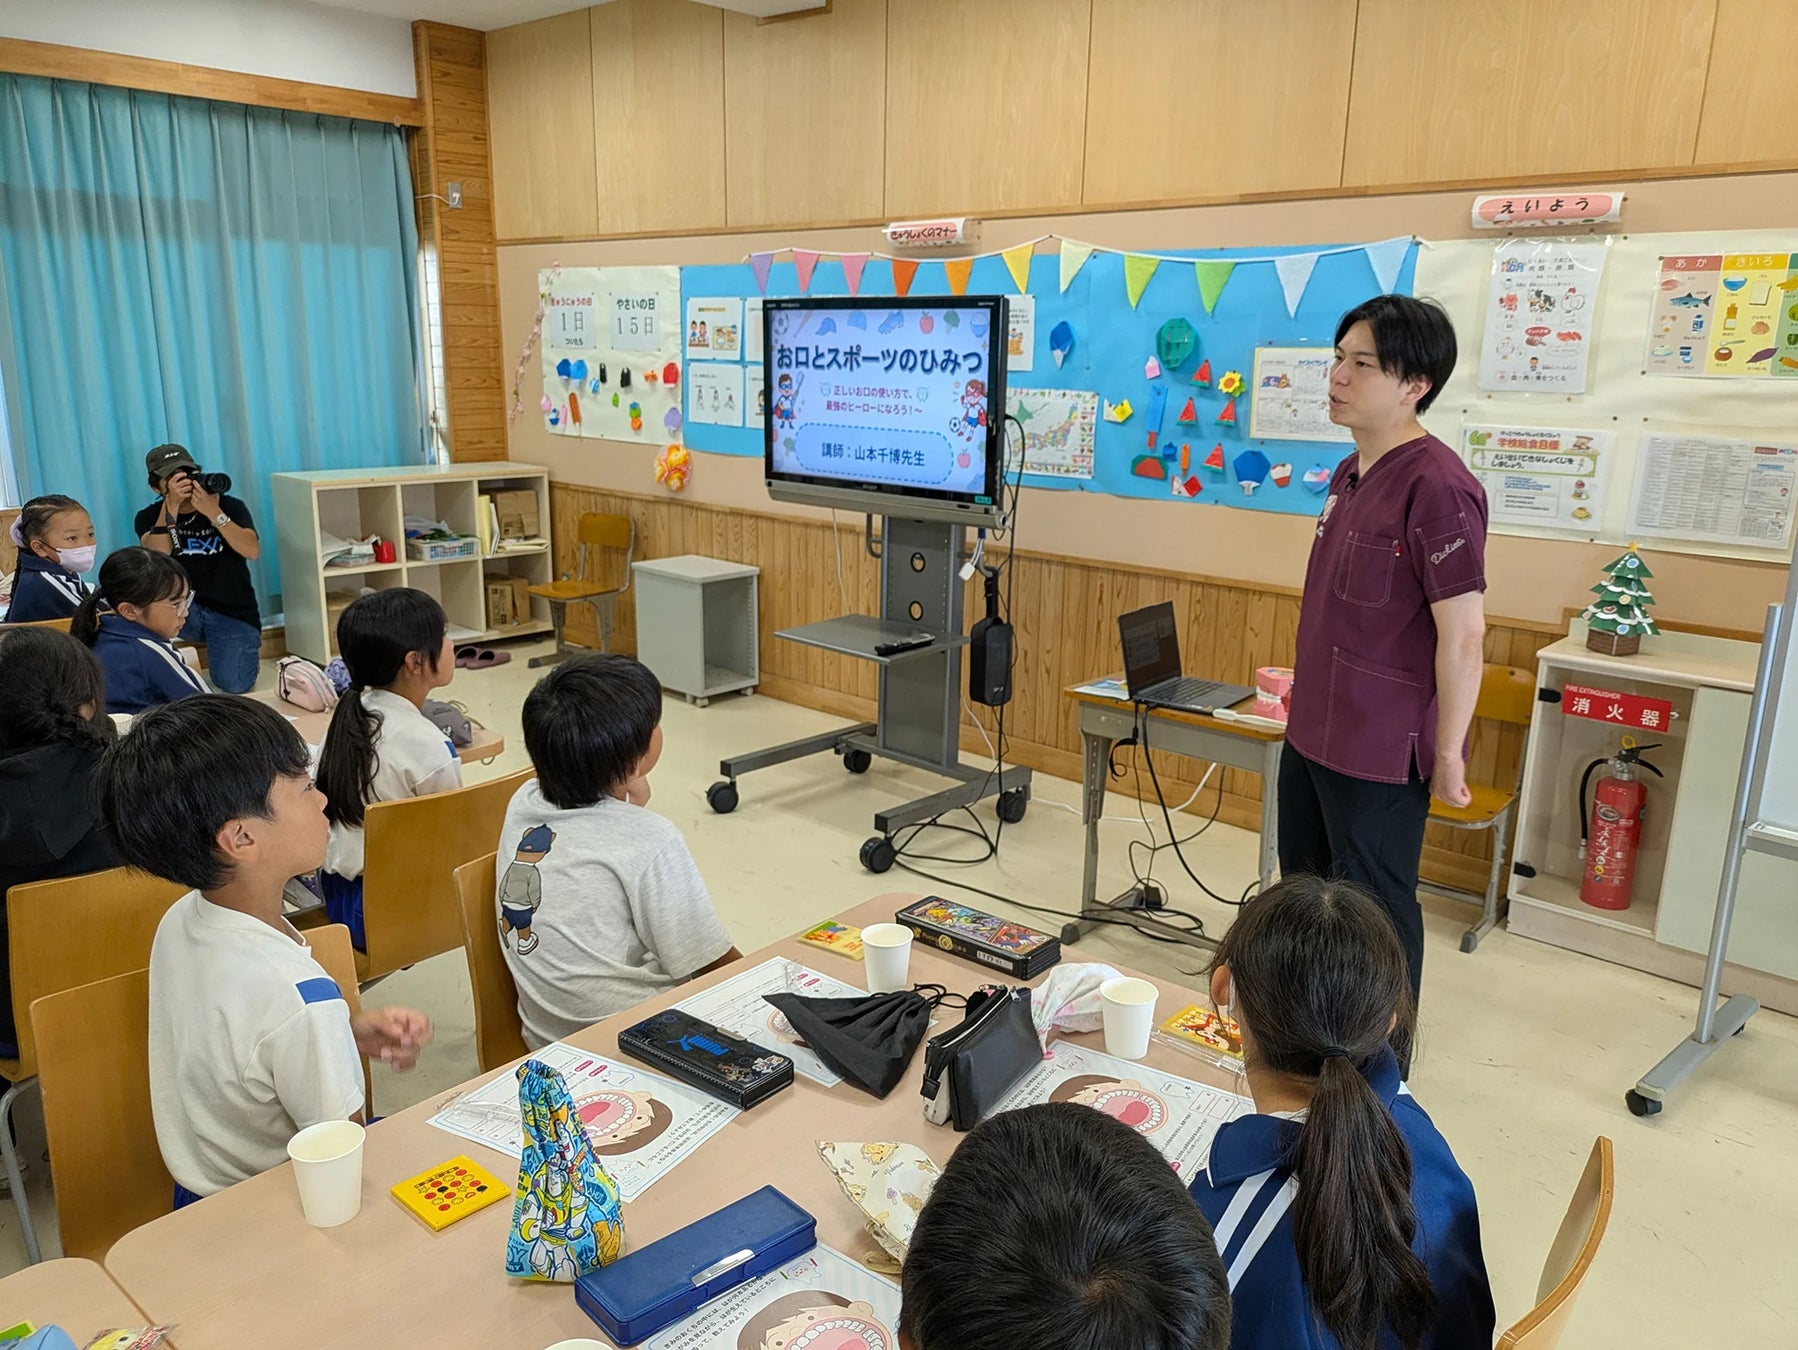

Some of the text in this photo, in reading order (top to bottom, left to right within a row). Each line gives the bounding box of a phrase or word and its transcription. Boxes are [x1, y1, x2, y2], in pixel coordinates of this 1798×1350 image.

[1500, 198, 1589, 214] えいよう
[1675, 259, 1708, 268] あか
[1736, 256, 1773, 267] きいろ
[617, 298, 655, 310] やさいの日
[777, 344, 983, 375] お口とスポーツのひみつ
[833, 385, 913, 399] 正しいお口の使い方で、
[171, 528, 180, 549] SONY
[1565, 684, 1621, 700] FIRE EXTINGUISHER
[1571, 697, 1660, 727] 消火器
